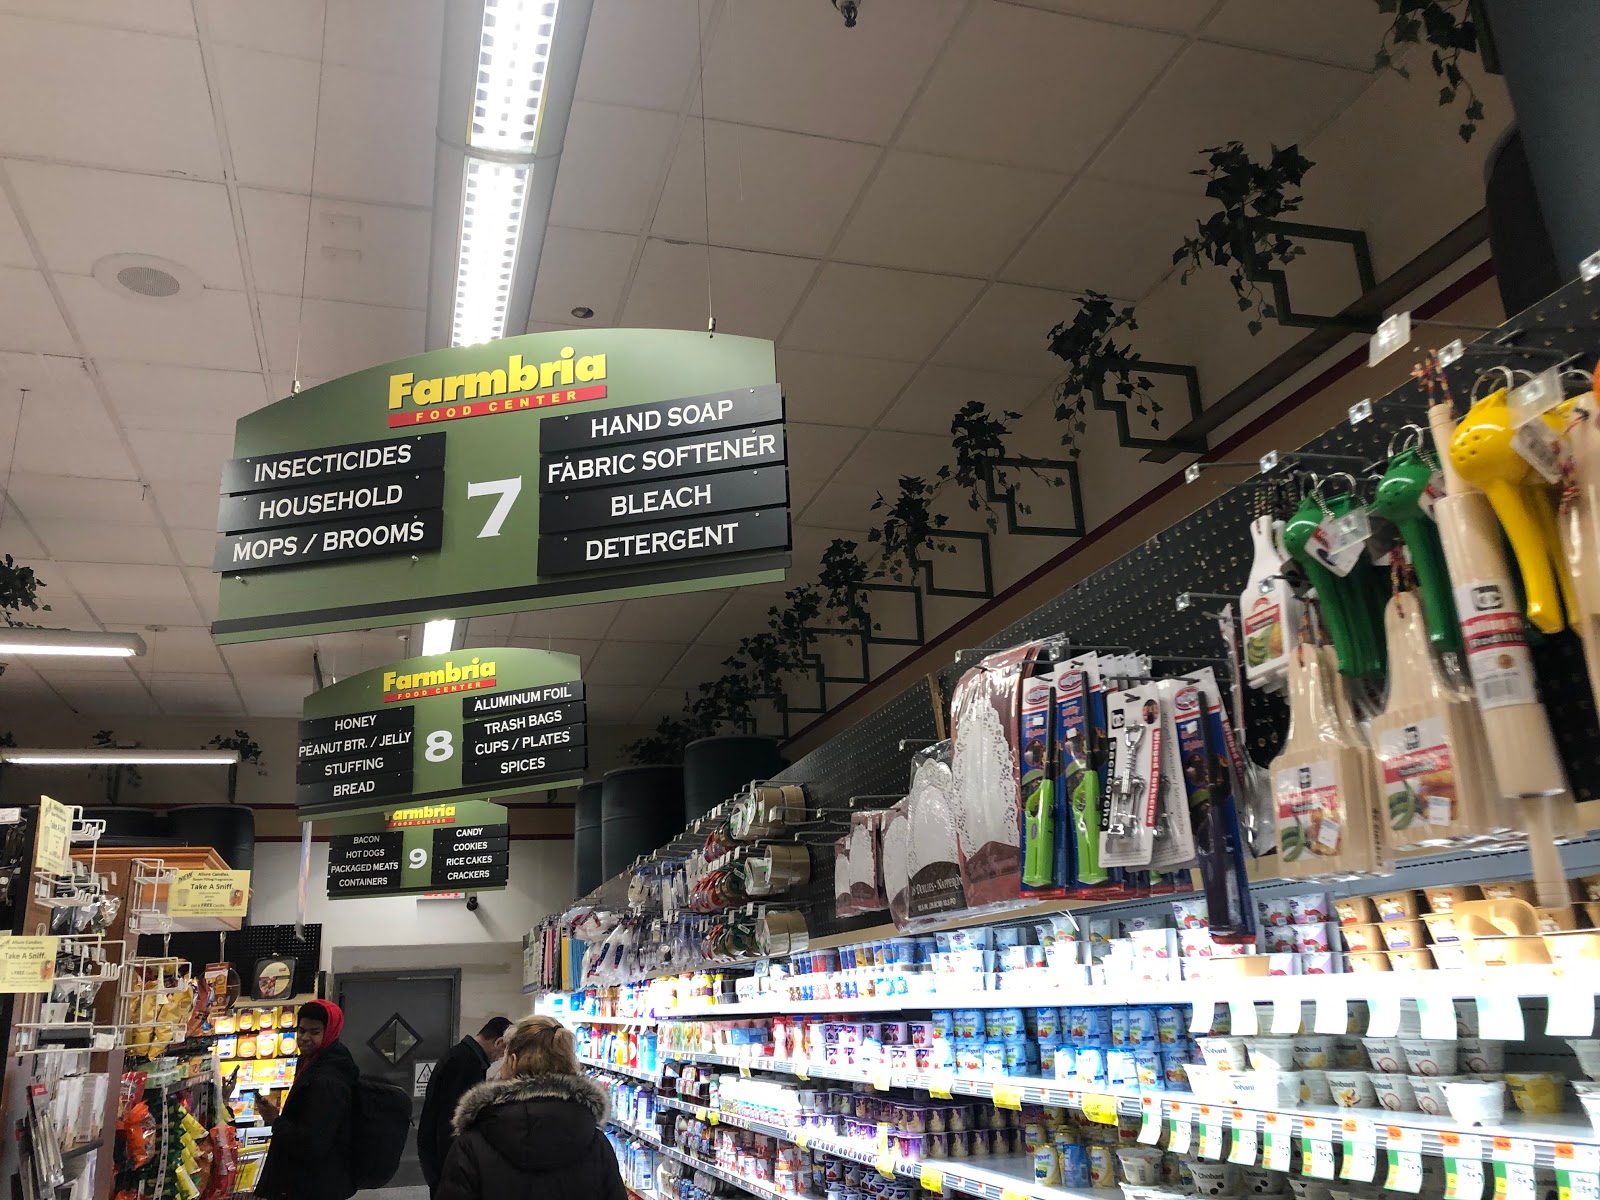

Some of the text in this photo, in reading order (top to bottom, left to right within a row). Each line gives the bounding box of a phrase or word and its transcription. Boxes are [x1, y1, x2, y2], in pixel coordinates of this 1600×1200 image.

[389, 347, 606, 409] Farmbria
[415, 391, 577, 422] FOOD CENTER
[591, 399, 734, 438] HAND SOAP
[254, 444, 412, 482] INSECTICIDES
[548, 434, 776, 484] FABRIC SOFTENER
[259, 484, 403, 520] HOUSEHOLD
[467, 475, 522, 539] 7
[611, 484, 712, 517] BLEACH
[233, 536, 298, 562] MOPS
[322, 521, 425, 552] BROOMS
[585, 522, 739, 561] DETERGENT
[384, 657, 496, 692] Farmbria
[397, 682, 481, 699] FOOD CENTER
[474, 686, 572, 712] ALUMINUM FOIL
[334, 714, 377, 731] HONEY
[484, 710, 562, 735] TRASH BAGS
[298, 741, 343, 758] PEANUT
[344, 737, 368, 752] BTR.
[379, 731, 412, 747] JELLY
[425, 730, 454, 763] 8
[475, 740, 509, 756] CUPS
[522, 730, 570, 749] PLATES
[1152, 730, 1161, 768] Winged
[324, 757, 384, 776] STUFFING
[500, 757, 546, 774] SPICES
[333, 780, 375, 797] BREAD
[1102, 740, 1117, 828] Sacacorcho
[353, 835, 380, 845] BACON
[456, 828, 483, 838] CANDY
[345, 849, 385, 859] HOT DOGS
[408, 848, 428, 869] 9
[453, 842, 488, 852] COOKIES
[330, 862, 399, 873] PACKAGED MEATS
[446, 855, 493, 866] RICE CAKES
[338, 877, 388, 887] CONTAINERS
[447, 870, 490, 881] CRACKERS
